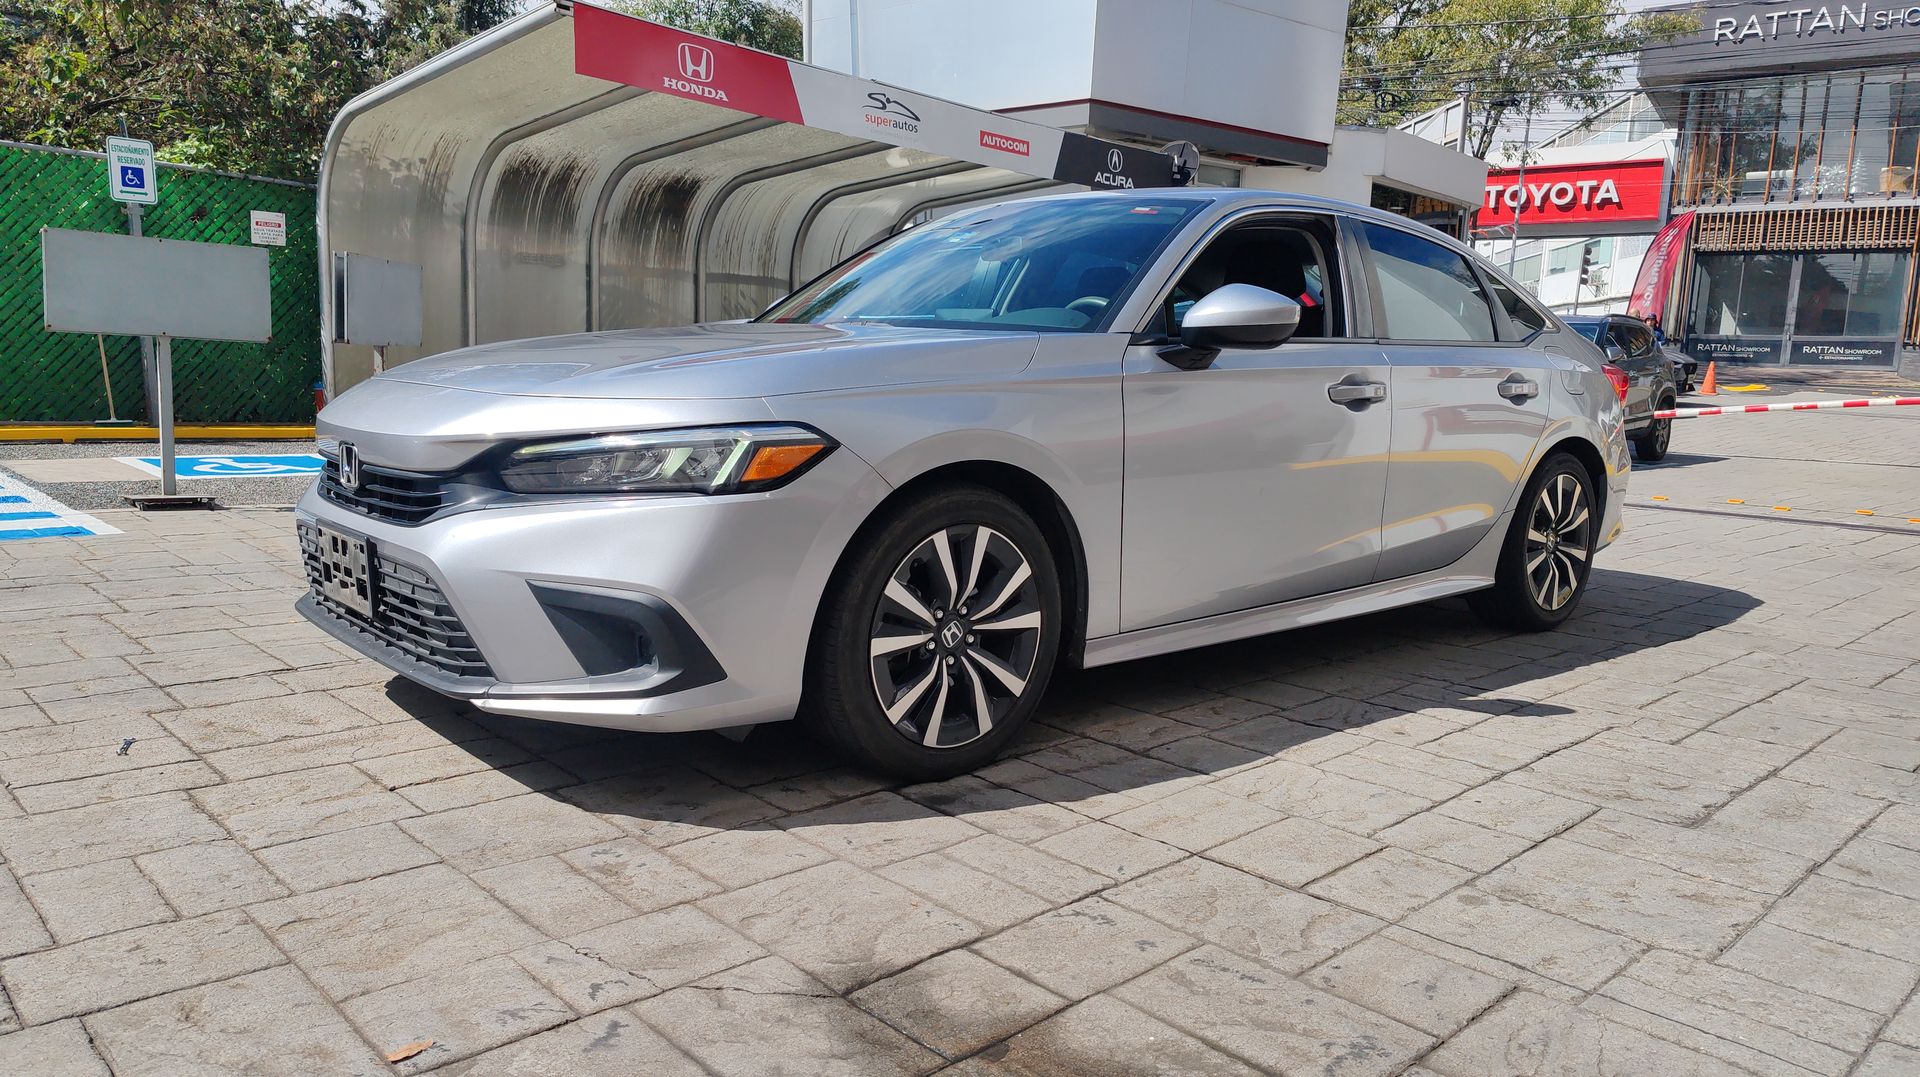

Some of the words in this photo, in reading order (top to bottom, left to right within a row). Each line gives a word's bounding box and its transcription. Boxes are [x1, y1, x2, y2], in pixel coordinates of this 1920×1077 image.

[1714, 2, 1867, 44] RATTAN
[663, 77, 728, 102] HONDA
[864, 113, 919, 133] superautos
[982, 134, 1028, 153] AUTOCOM
[117, 156, 145, 166] RESERVADO
[1094, 171, 1134, 189] ACURA
[1485, 179, 1620, 209] TOYOTA
[1697, 343, 1735, 352] RATTAN
[1803, 345, 1844, 354] RATTAN
